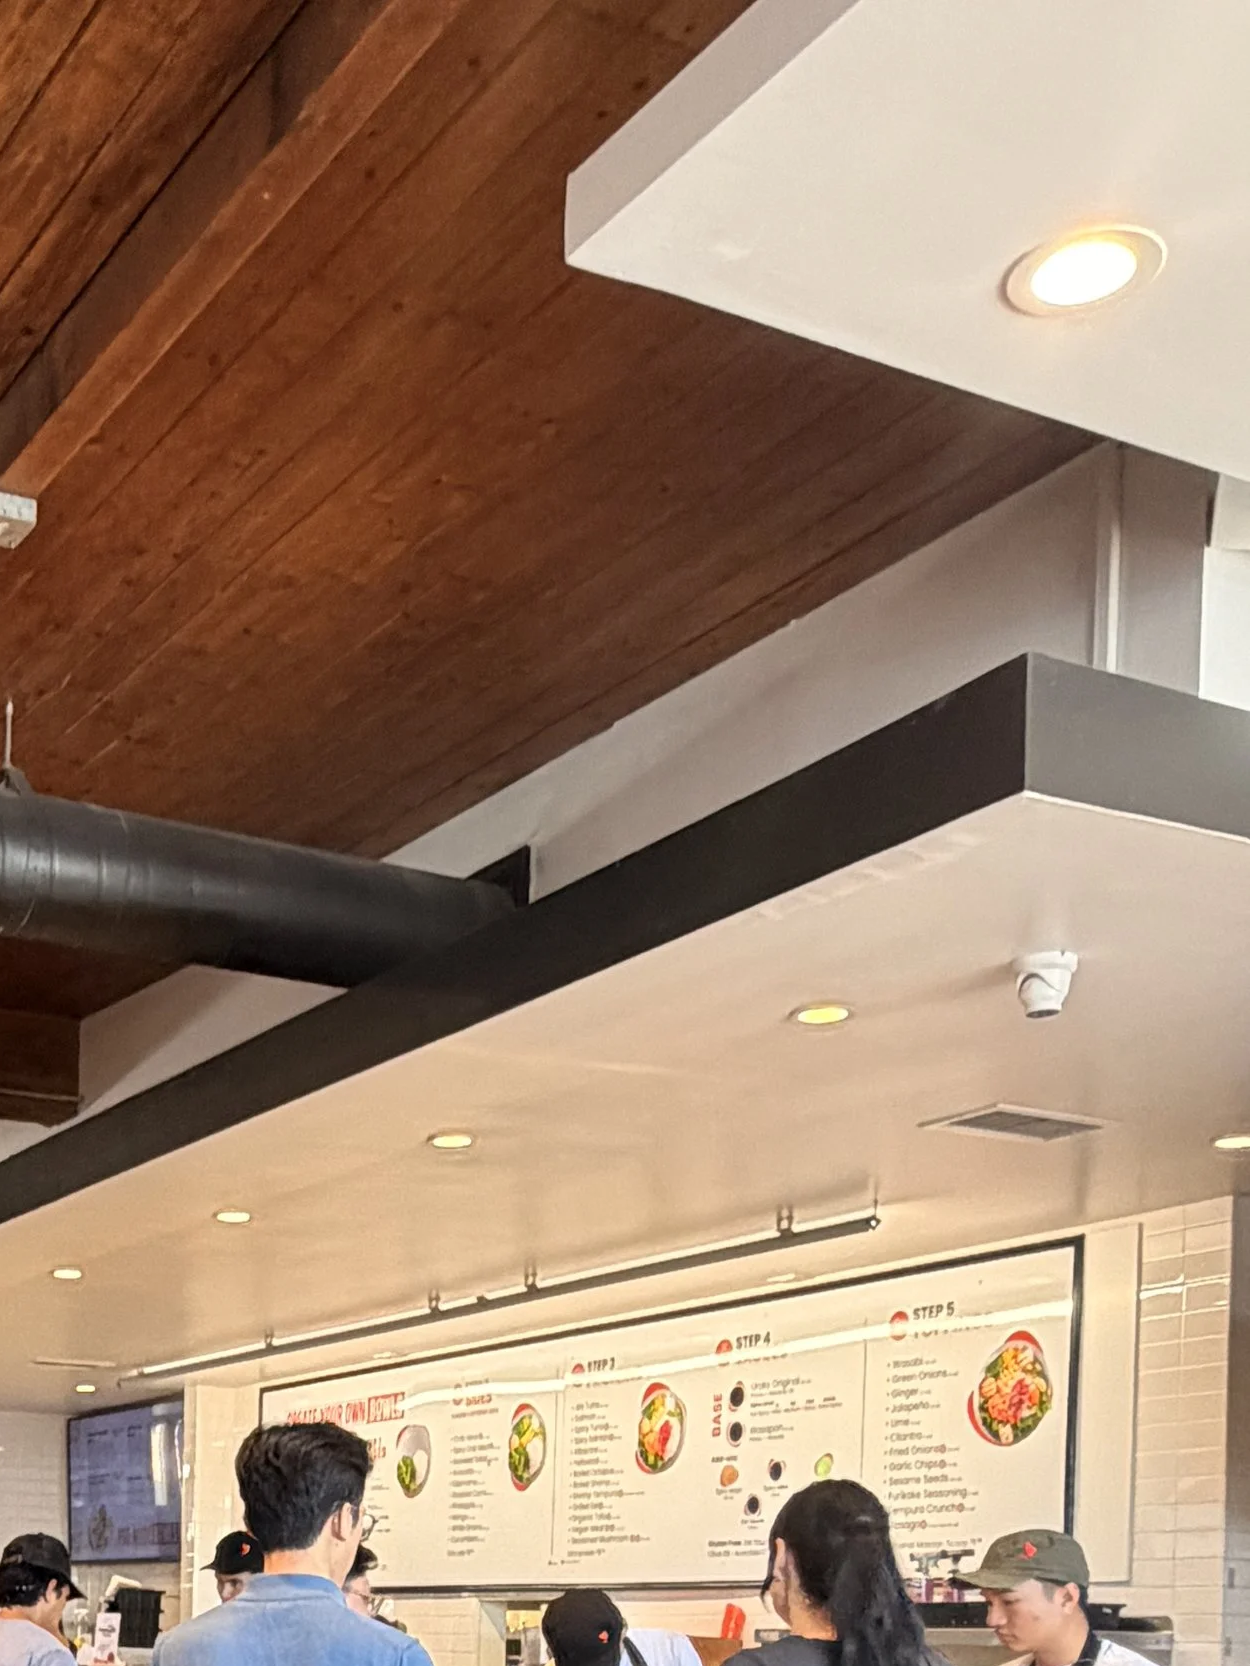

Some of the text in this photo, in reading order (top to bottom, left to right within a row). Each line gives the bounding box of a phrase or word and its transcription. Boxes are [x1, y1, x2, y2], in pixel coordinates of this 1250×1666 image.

[913, 1301, 955, 1320] STEP 5
[736, 1331, 771, 1350] STEP 4
[891, 1388, 919, 1400] Ginger
[711, 1393, 723, 1437] BASE
[892, 1505, 925, 1517] empura
